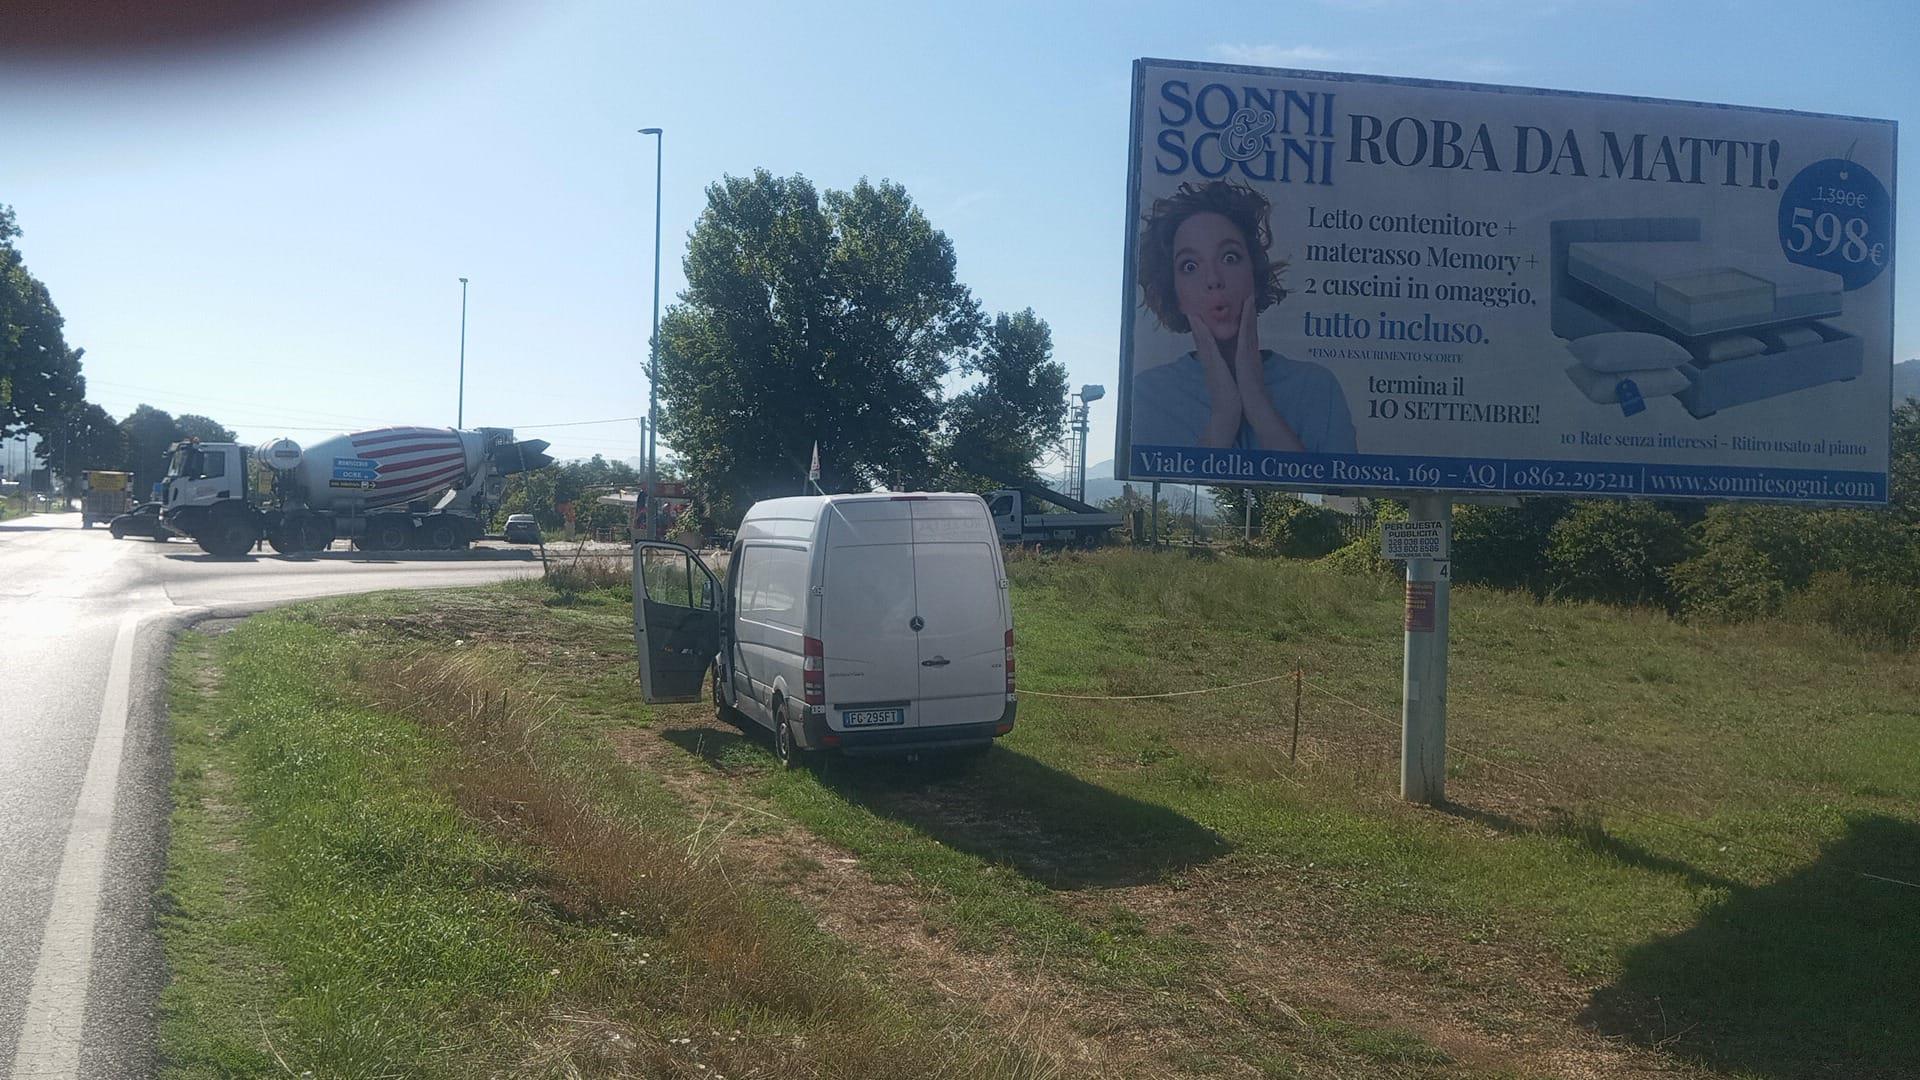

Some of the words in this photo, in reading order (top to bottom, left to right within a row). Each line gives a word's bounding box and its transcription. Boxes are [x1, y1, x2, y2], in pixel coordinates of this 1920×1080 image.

[1158, 80, 1336, 137] SONNI
[1155, 128, 1335, 186] SOGNI
[1345, 113, 1502, 172] ROBA
[1511, 125, 1588, 177] DA
[1599, 130, 1780, 190] MATTI!
[1307, 206, 1363, 231] Letto
[1368, 212, 1499, 238] contenitore
[1305, 242, 1421, 267] materasso
[1426, 246, 1520, 276] Memory
[1304, 277, 1317, 295] 2
[1322, 275, 1401, 298] cuscini
[1407, 276, 1429, 300] in
[1303, 311, 1371, 338] tutto
[1378, 311, 1490, 345] incluso.
[1346, 349, 1421, 362] ESAURIMENTO
[1422, 353, 1464, 364] SCORTE
[1368, 375, 1447, 397] termina
[1452, 376, 1465, 397] il
[1368, 398, 1399, 419] 10
[1403, 400, 1540, 425] SETTEMBRE!
[1560, 432, 1576, 445] 10
[1580, 431, 1612, 447] Rate
[1614, 434, 1655, 448] senza
[1658, 432, 1718, 449] interessi
[1732, 435, 1771, 451] Ritiro
[1774, 440, 1811, 454] usato
[1813, 439, 1826, 454] al
[1828, 440, 1867, 456] piano
[1140, 452, 1195, 475] Viale
[1201, 454, 1254, 476] della
[1260, 456, 1325, 480] Croce
[1407, 463, 1441, 485] 169
[1463, 463, 1497, 488] AQ
[1513, 466, 1634, 490] 0862.295211
[1650, 472, 1876, 499] www.sonniesogni.com
[1405, 521, 1443, 530] QUESTA
[1440, 564, 1449, 578] 4
